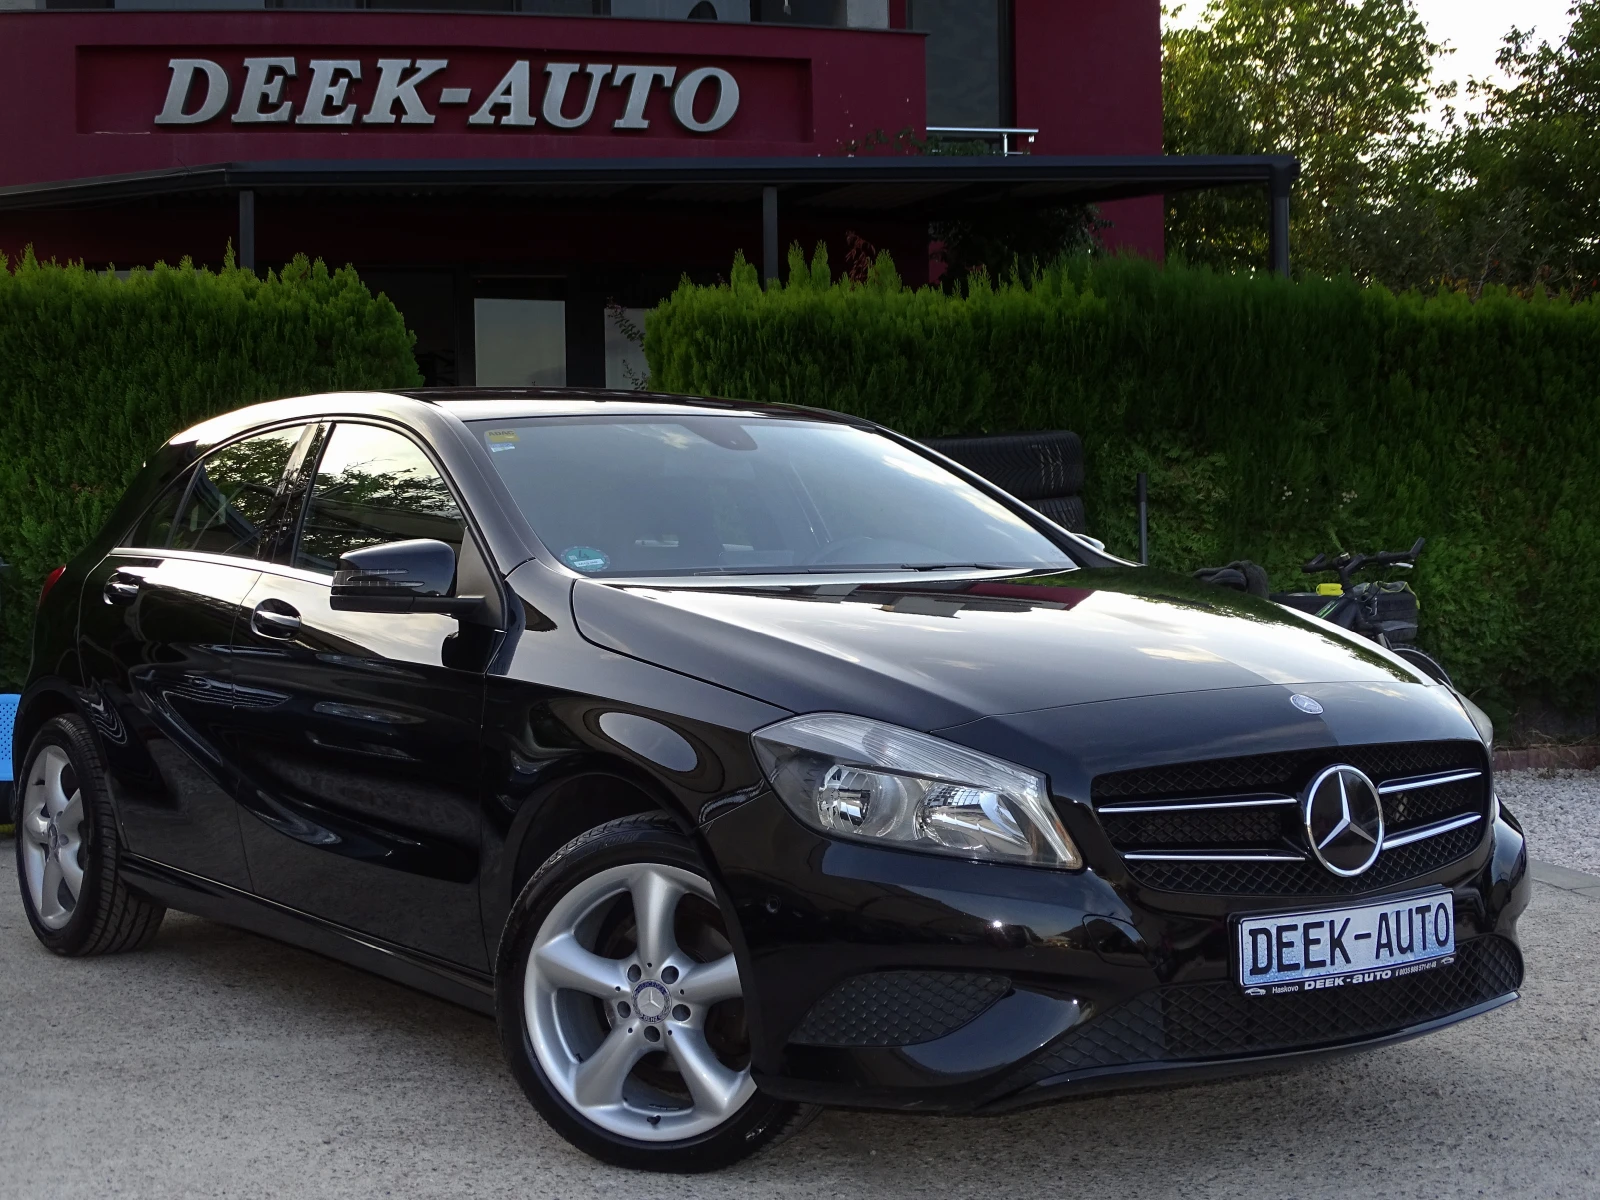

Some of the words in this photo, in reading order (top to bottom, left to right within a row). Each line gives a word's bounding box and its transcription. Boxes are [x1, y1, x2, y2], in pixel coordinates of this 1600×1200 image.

[154, 57, 740, 132] DEEK-AUTO
[1248, 902, 1450, 976] DEEK-AUTO
[1272, 985, 1299, 994] Haskovo
